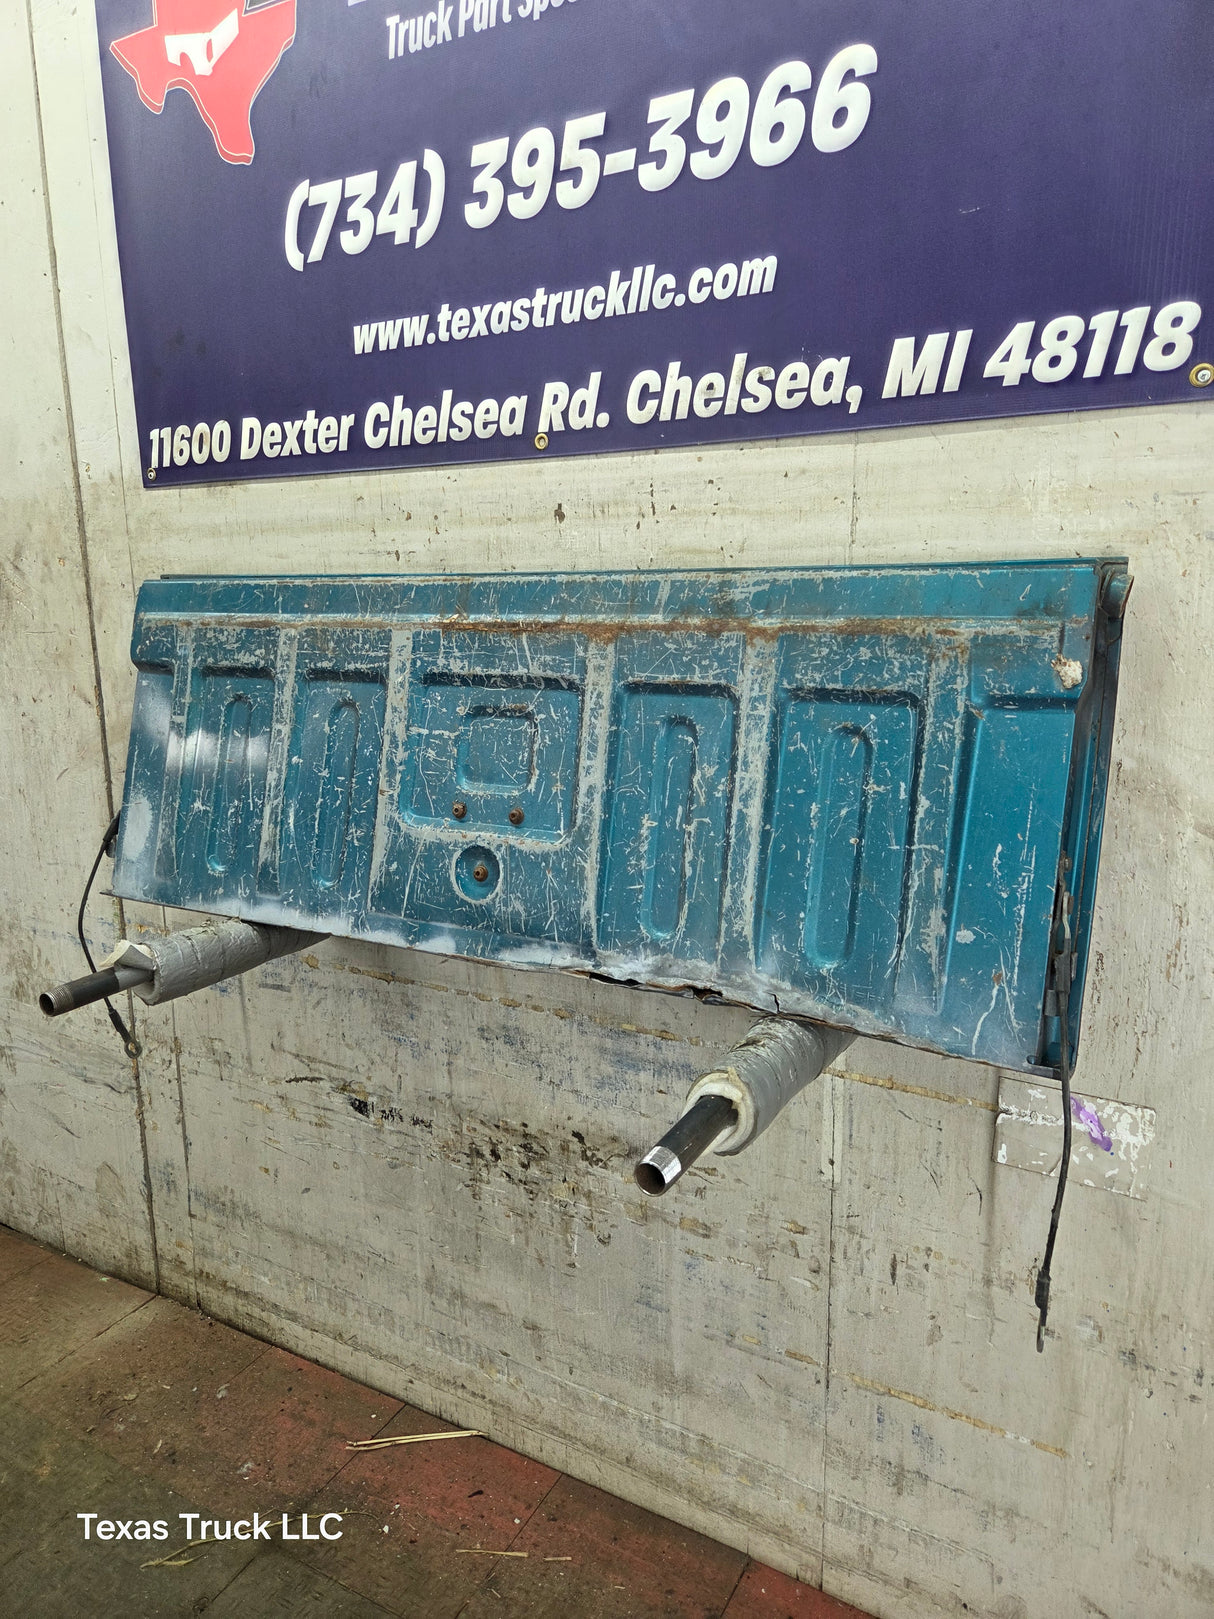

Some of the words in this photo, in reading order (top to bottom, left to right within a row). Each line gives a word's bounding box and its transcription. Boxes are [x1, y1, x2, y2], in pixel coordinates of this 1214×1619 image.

[386, 0, 454, 60] Truck
[284, 146, 446, 272] (734)
[463, 41, 878, 231] 395-3966
[352, 254, 778, 356] www.texastruckllc.com
[147, 420, 232, 469] 11600
[239, 409, 355, 461] Dexter
[363, 389, 529, 449] Chelsea
[537, 370, 611, 434] Rd.
[626, 352, 863, 426] Chelsea,
[881, 328, 974, 400] MI
[982, 300, 1202, 388] 48118
